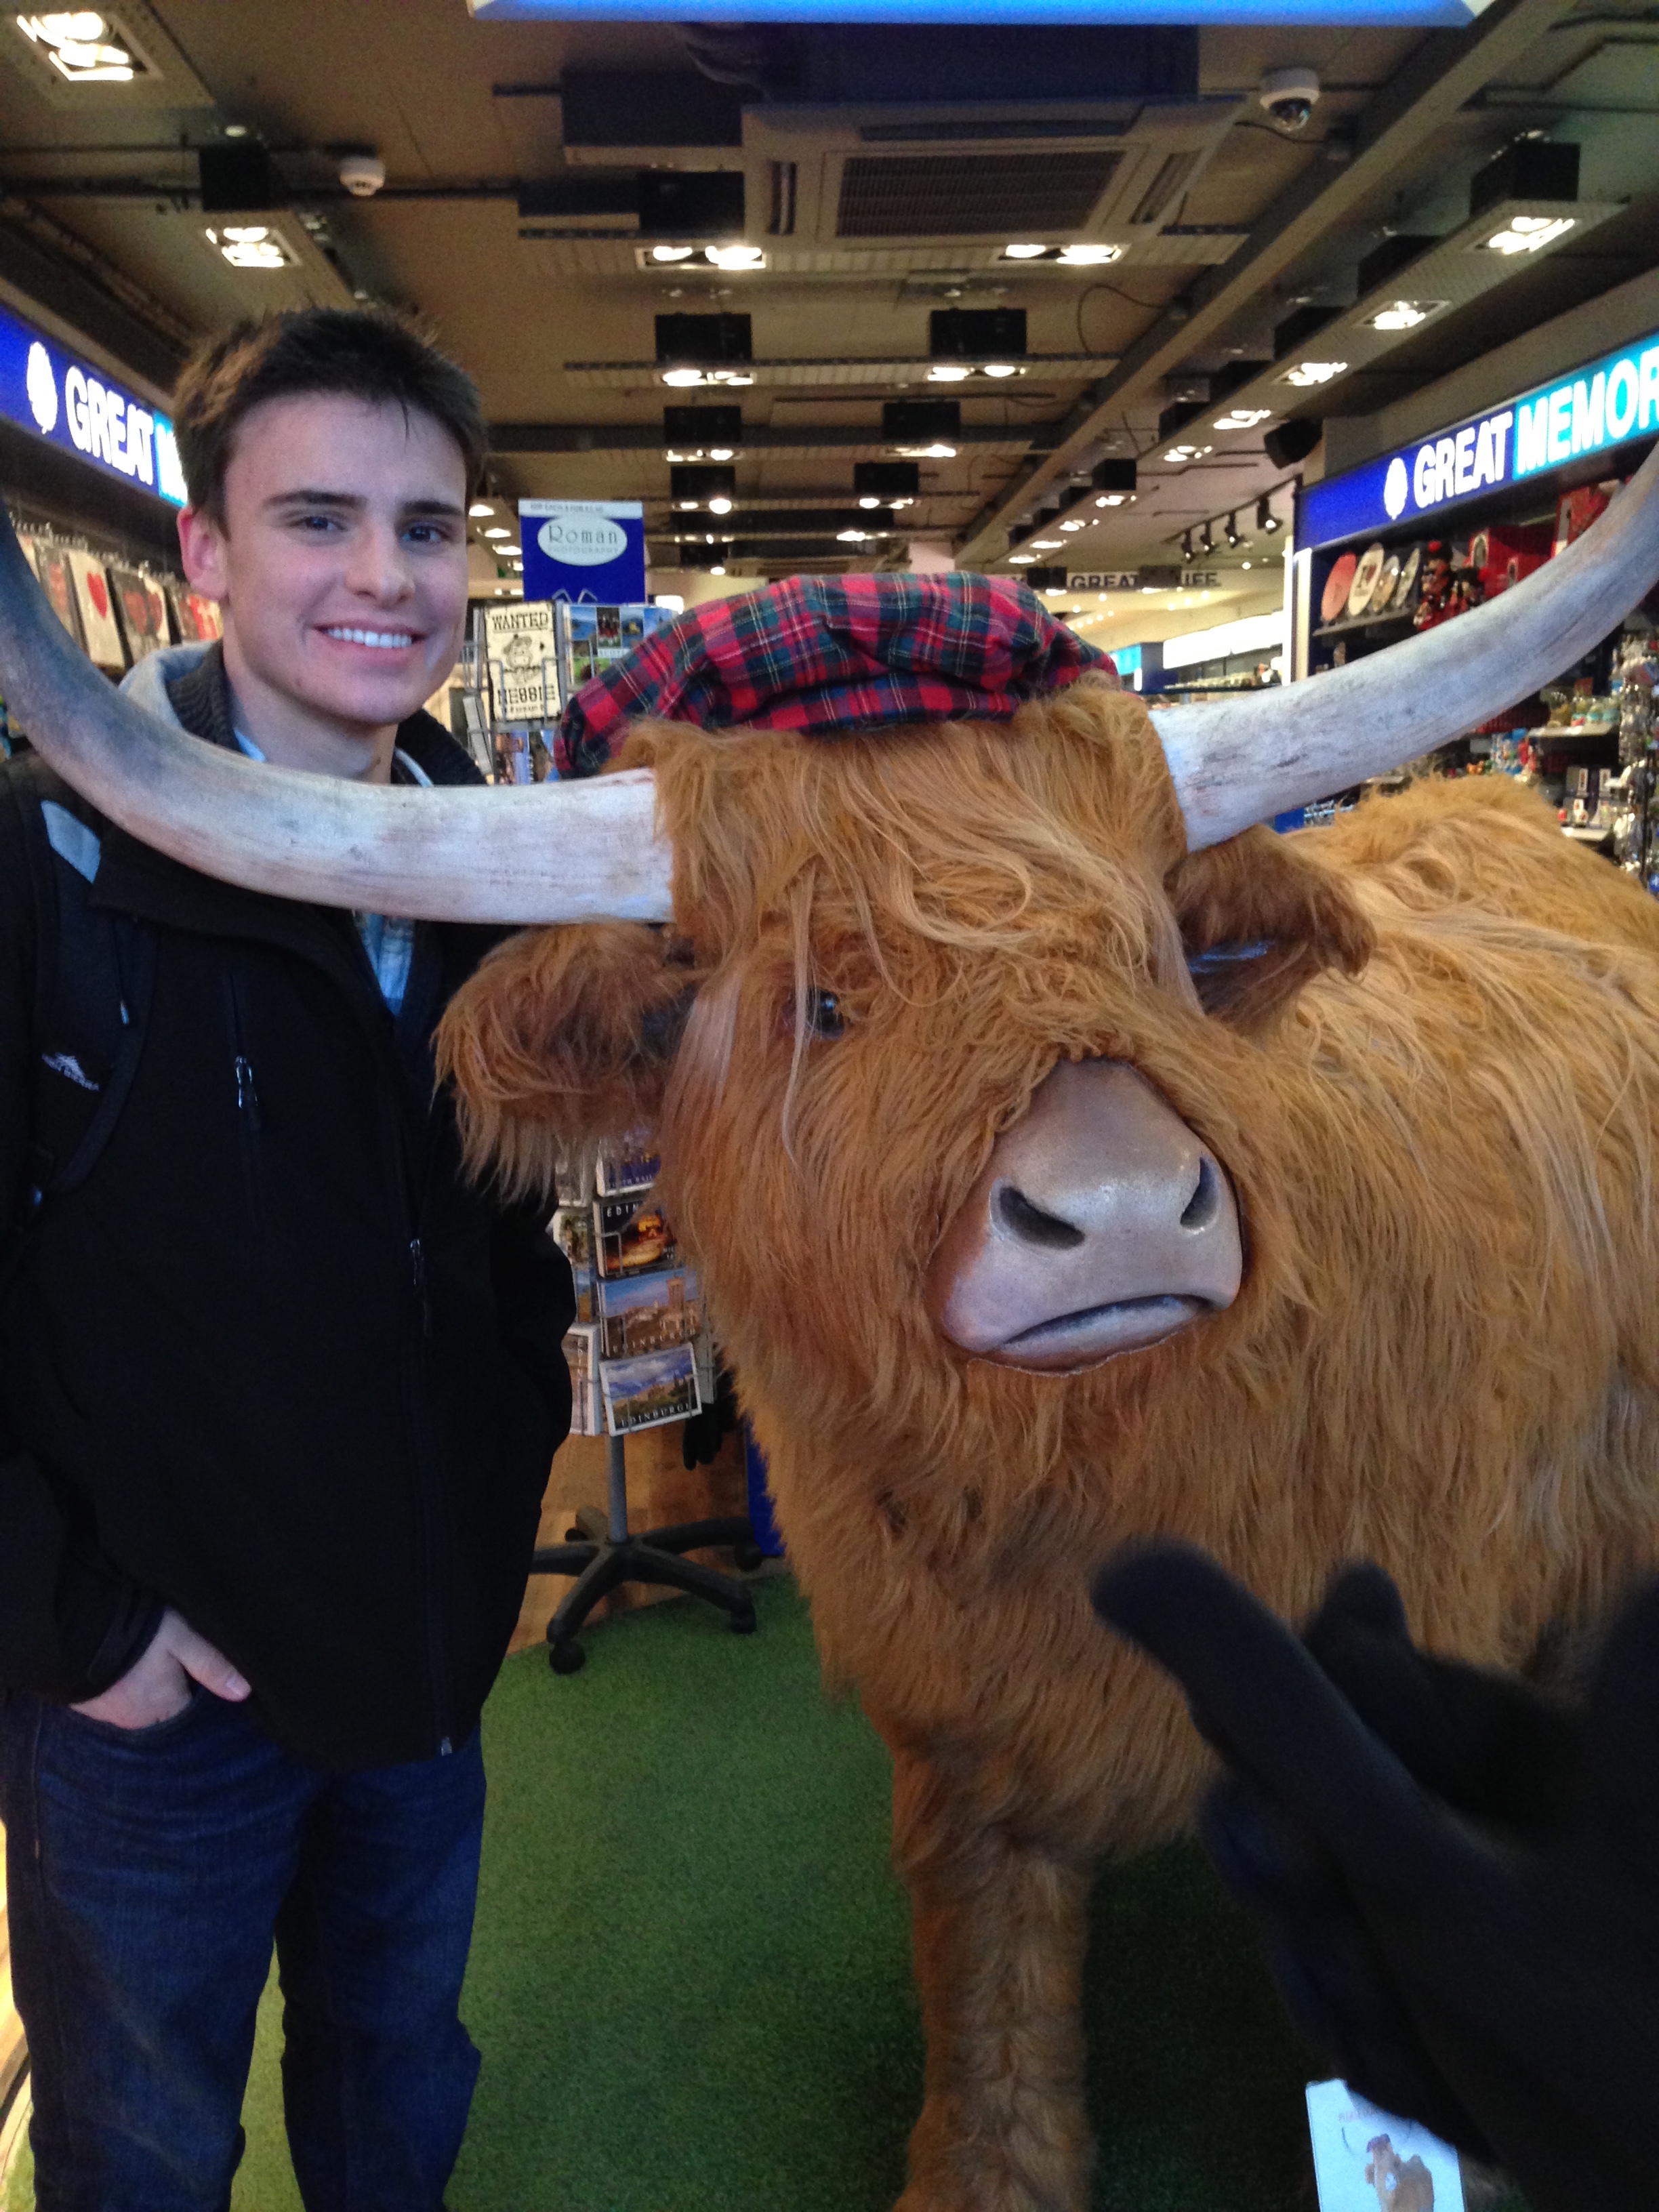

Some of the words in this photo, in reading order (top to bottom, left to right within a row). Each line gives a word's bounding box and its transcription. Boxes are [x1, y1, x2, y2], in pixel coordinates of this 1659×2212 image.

[65, 365, 155, 486] GREAT
[1414, 411, 1513, 509] GREAT
[1517, 346, 1659, 474] MEMOR
[548, 525, 618, 545] Roman
[1071, 573, 1140, 590] GREAT
[491, 612, 548, 630] WANTED
[613, 1326, 697, 1353] EINBURH
